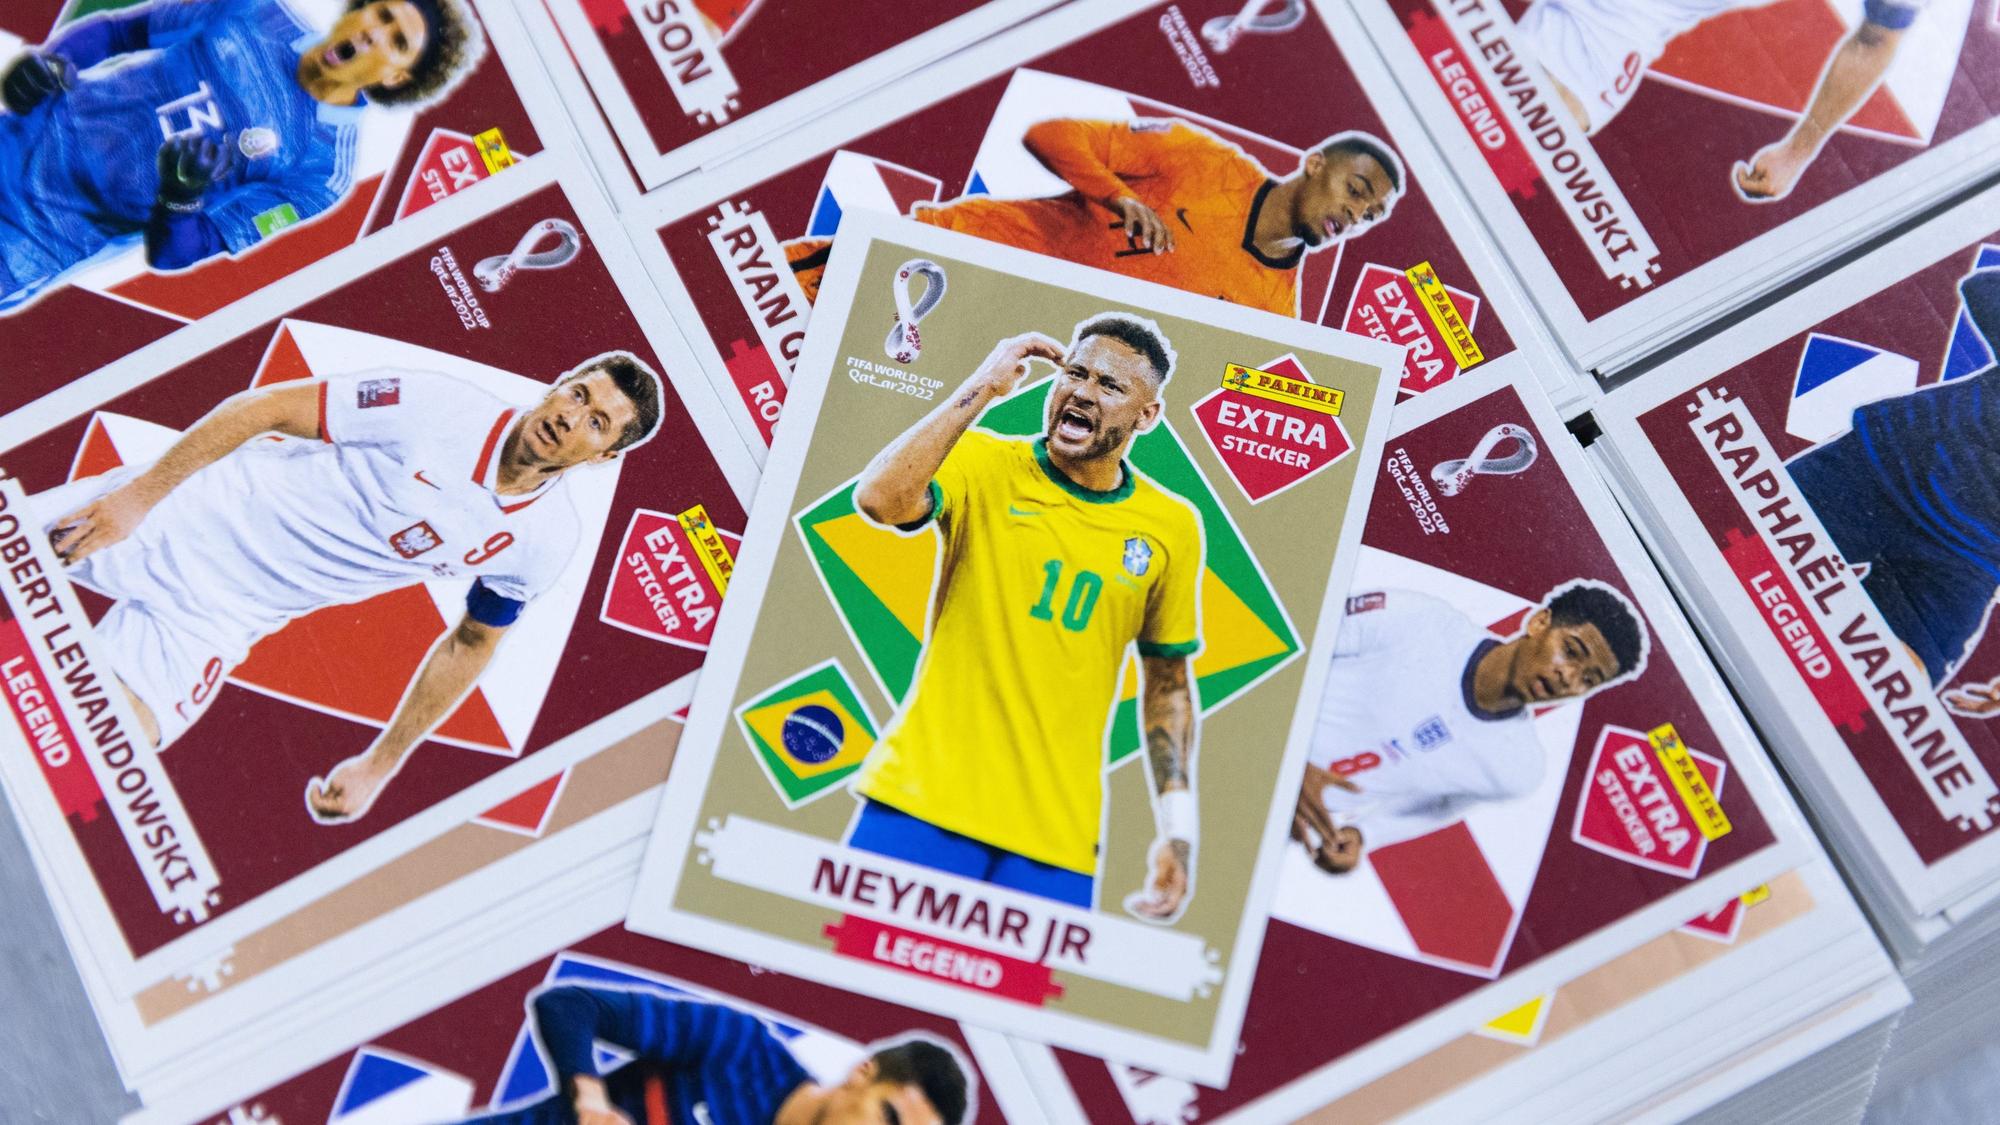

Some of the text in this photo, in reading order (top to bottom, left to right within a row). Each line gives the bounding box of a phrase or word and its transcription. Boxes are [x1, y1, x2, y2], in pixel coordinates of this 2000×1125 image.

[1168, 5, 1221, 88] FIFA WORLD CUP
[1615, 51, 1641, 94] 9
[155, 80, 223, 141] 13
[1431, 48, 1507, 149] LEGEND
[1470, 21, 1638, 262] LEWANDOWSKI
[438, 246, 490, 328] FIFA WORLD CUP
[721, 223, 806, 374] RYAN G
[1431, 290, 1479, 362] PANINI
[1373, 280, 1445, 383] EXTRA
[846, 356, 944, 390] FIFA WORLD CUP
[1257, 374, 1339, 405] PANINI
[1216, 400, 1328, 450] EXTRA
[1221, 434, 1311, 471] STICKER
[1394, 447, 1450, 535] FIFA WORLD CUP
[464, 531, 515, 566] 9
[644, 526, 716, 632] EXTRA
[704, 535, 733, 583] PAN
[626, 551, 681, 634] STICKER
[1029, 559, 1103, 632] 10
[1703, 411, 1976, 798] RAPHAËL VARANE
[1750, 570, 1832, 679] LEGEND
[1, 655, 71, 768] LEGEND
[192, 656, 222, 704] 9
[43, 623, 197, 893] LEWANDOWSKI
[1329, 752, 1381, 778] 8
[1676, 756, 1724, 831] PANINI
[1596, 768, 1656, 858] STICKER
[1613, 744, 1691, 857] EXTRA
[811, 857, 1093, 964] NEYMAR JR
[872, 929, 1004, 989] LEGEND
